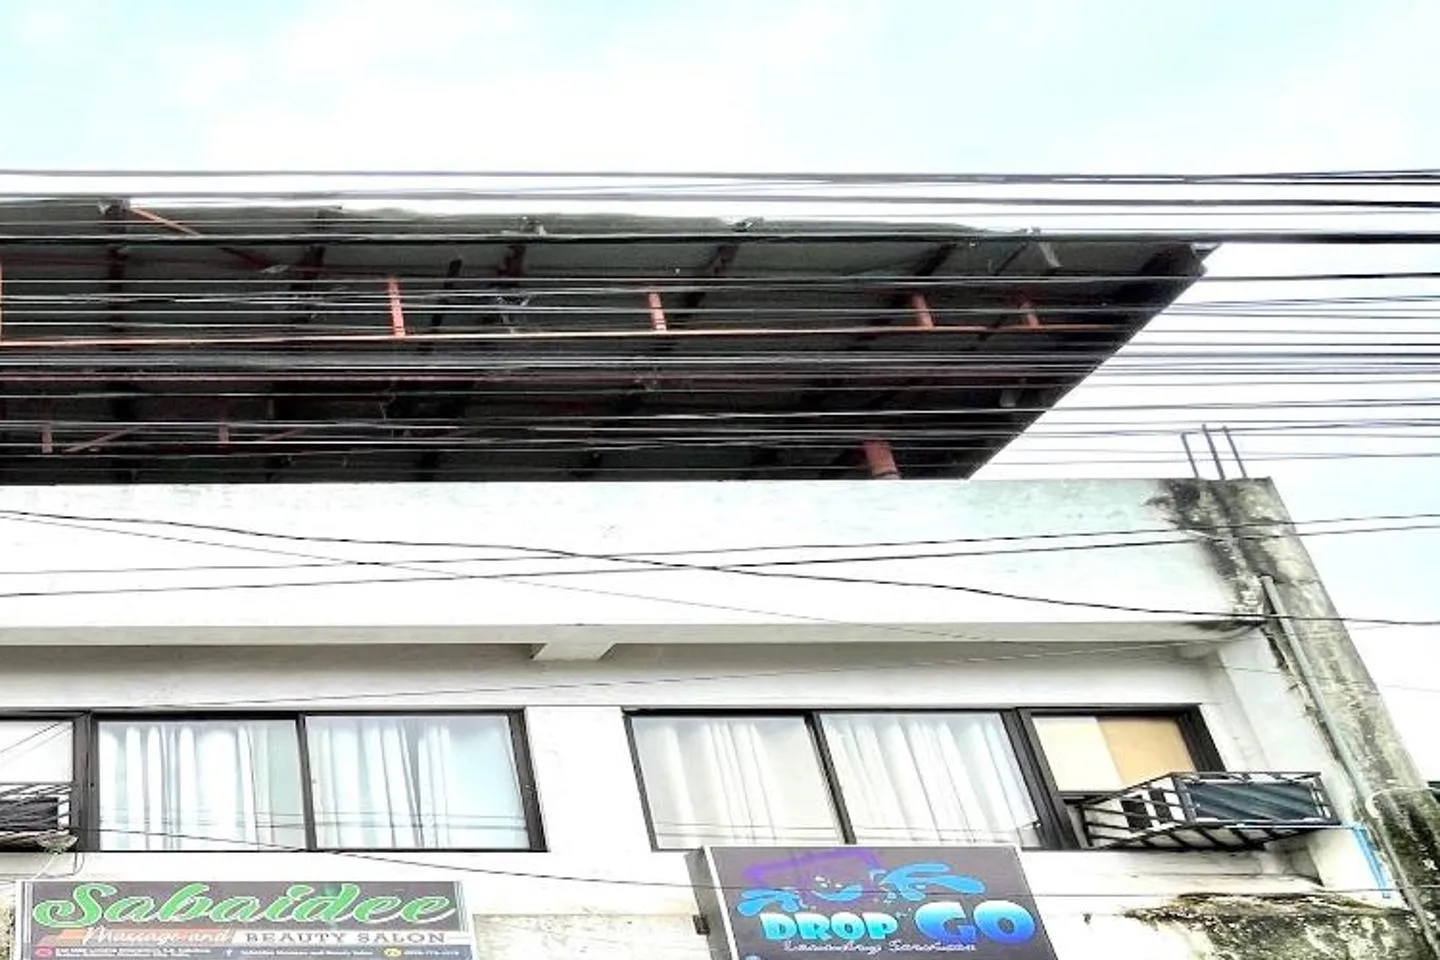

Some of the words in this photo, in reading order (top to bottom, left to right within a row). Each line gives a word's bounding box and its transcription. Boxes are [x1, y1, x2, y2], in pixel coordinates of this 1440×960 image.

[32, 882, 458, 928] Sabaidee
[759, 911, 899, 941] DROP
[914, 900, 1036, 944] GO
[245, 931, 349, 943] BEAUTY
[357, 931, 446, 943] SALON
